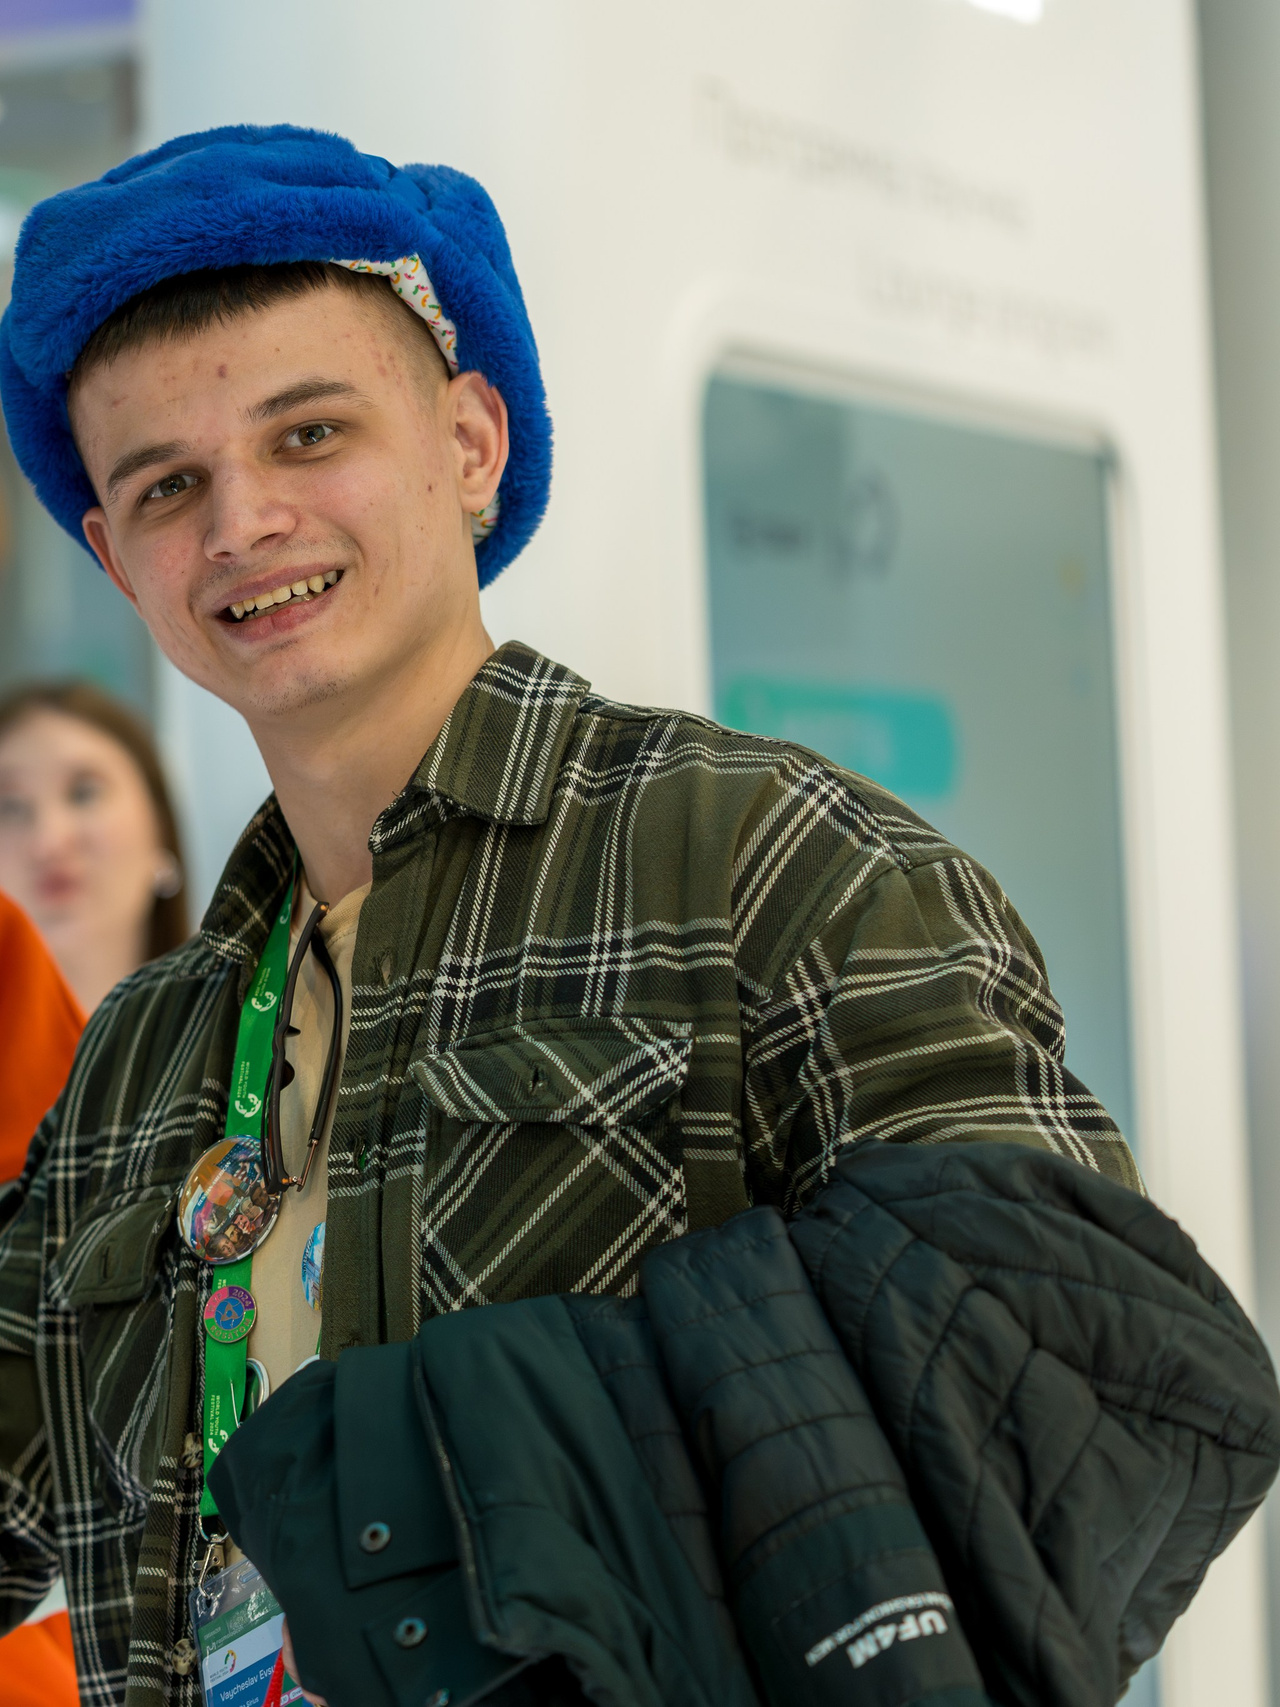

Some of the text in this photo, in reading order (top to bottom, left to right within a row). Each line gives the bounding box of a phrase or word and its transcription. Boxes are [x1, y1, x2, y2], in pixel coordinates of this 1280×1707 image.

[232, 1288, 252, 1307] 2024
[210, 1318, 252, 1340] ROSATOM
[846, 1609, 949, 1669] UF4M
[220, 1675, 259, 1702] Vaycheslav
